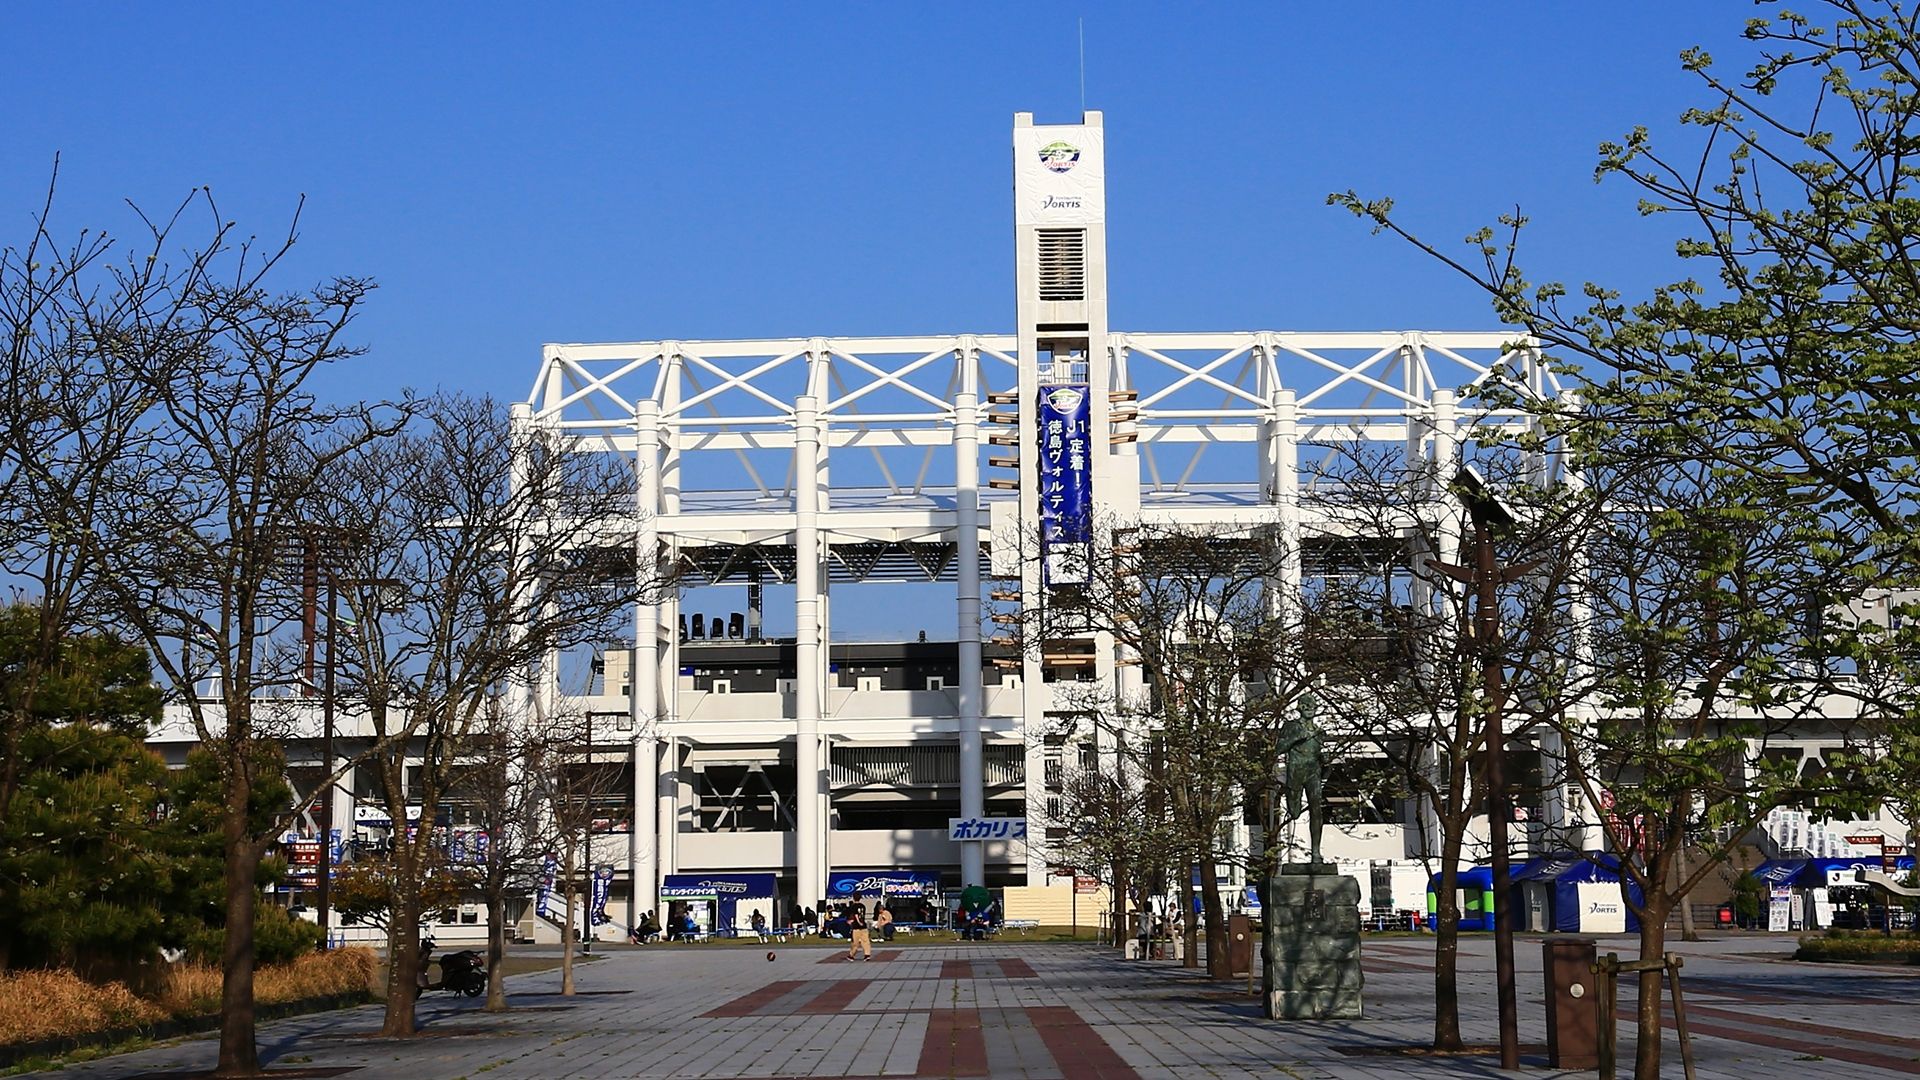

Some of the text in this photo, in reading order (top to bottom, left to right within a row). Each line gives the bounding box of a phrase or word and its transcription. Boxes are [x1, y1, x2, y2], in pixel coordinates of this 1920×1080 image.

[1040, 195, 1081, 210] VORTIS
[1048, 420, 1064, 538] 徳島ヴォルティス
[1591, 902, 1617, 914] VORTIS
